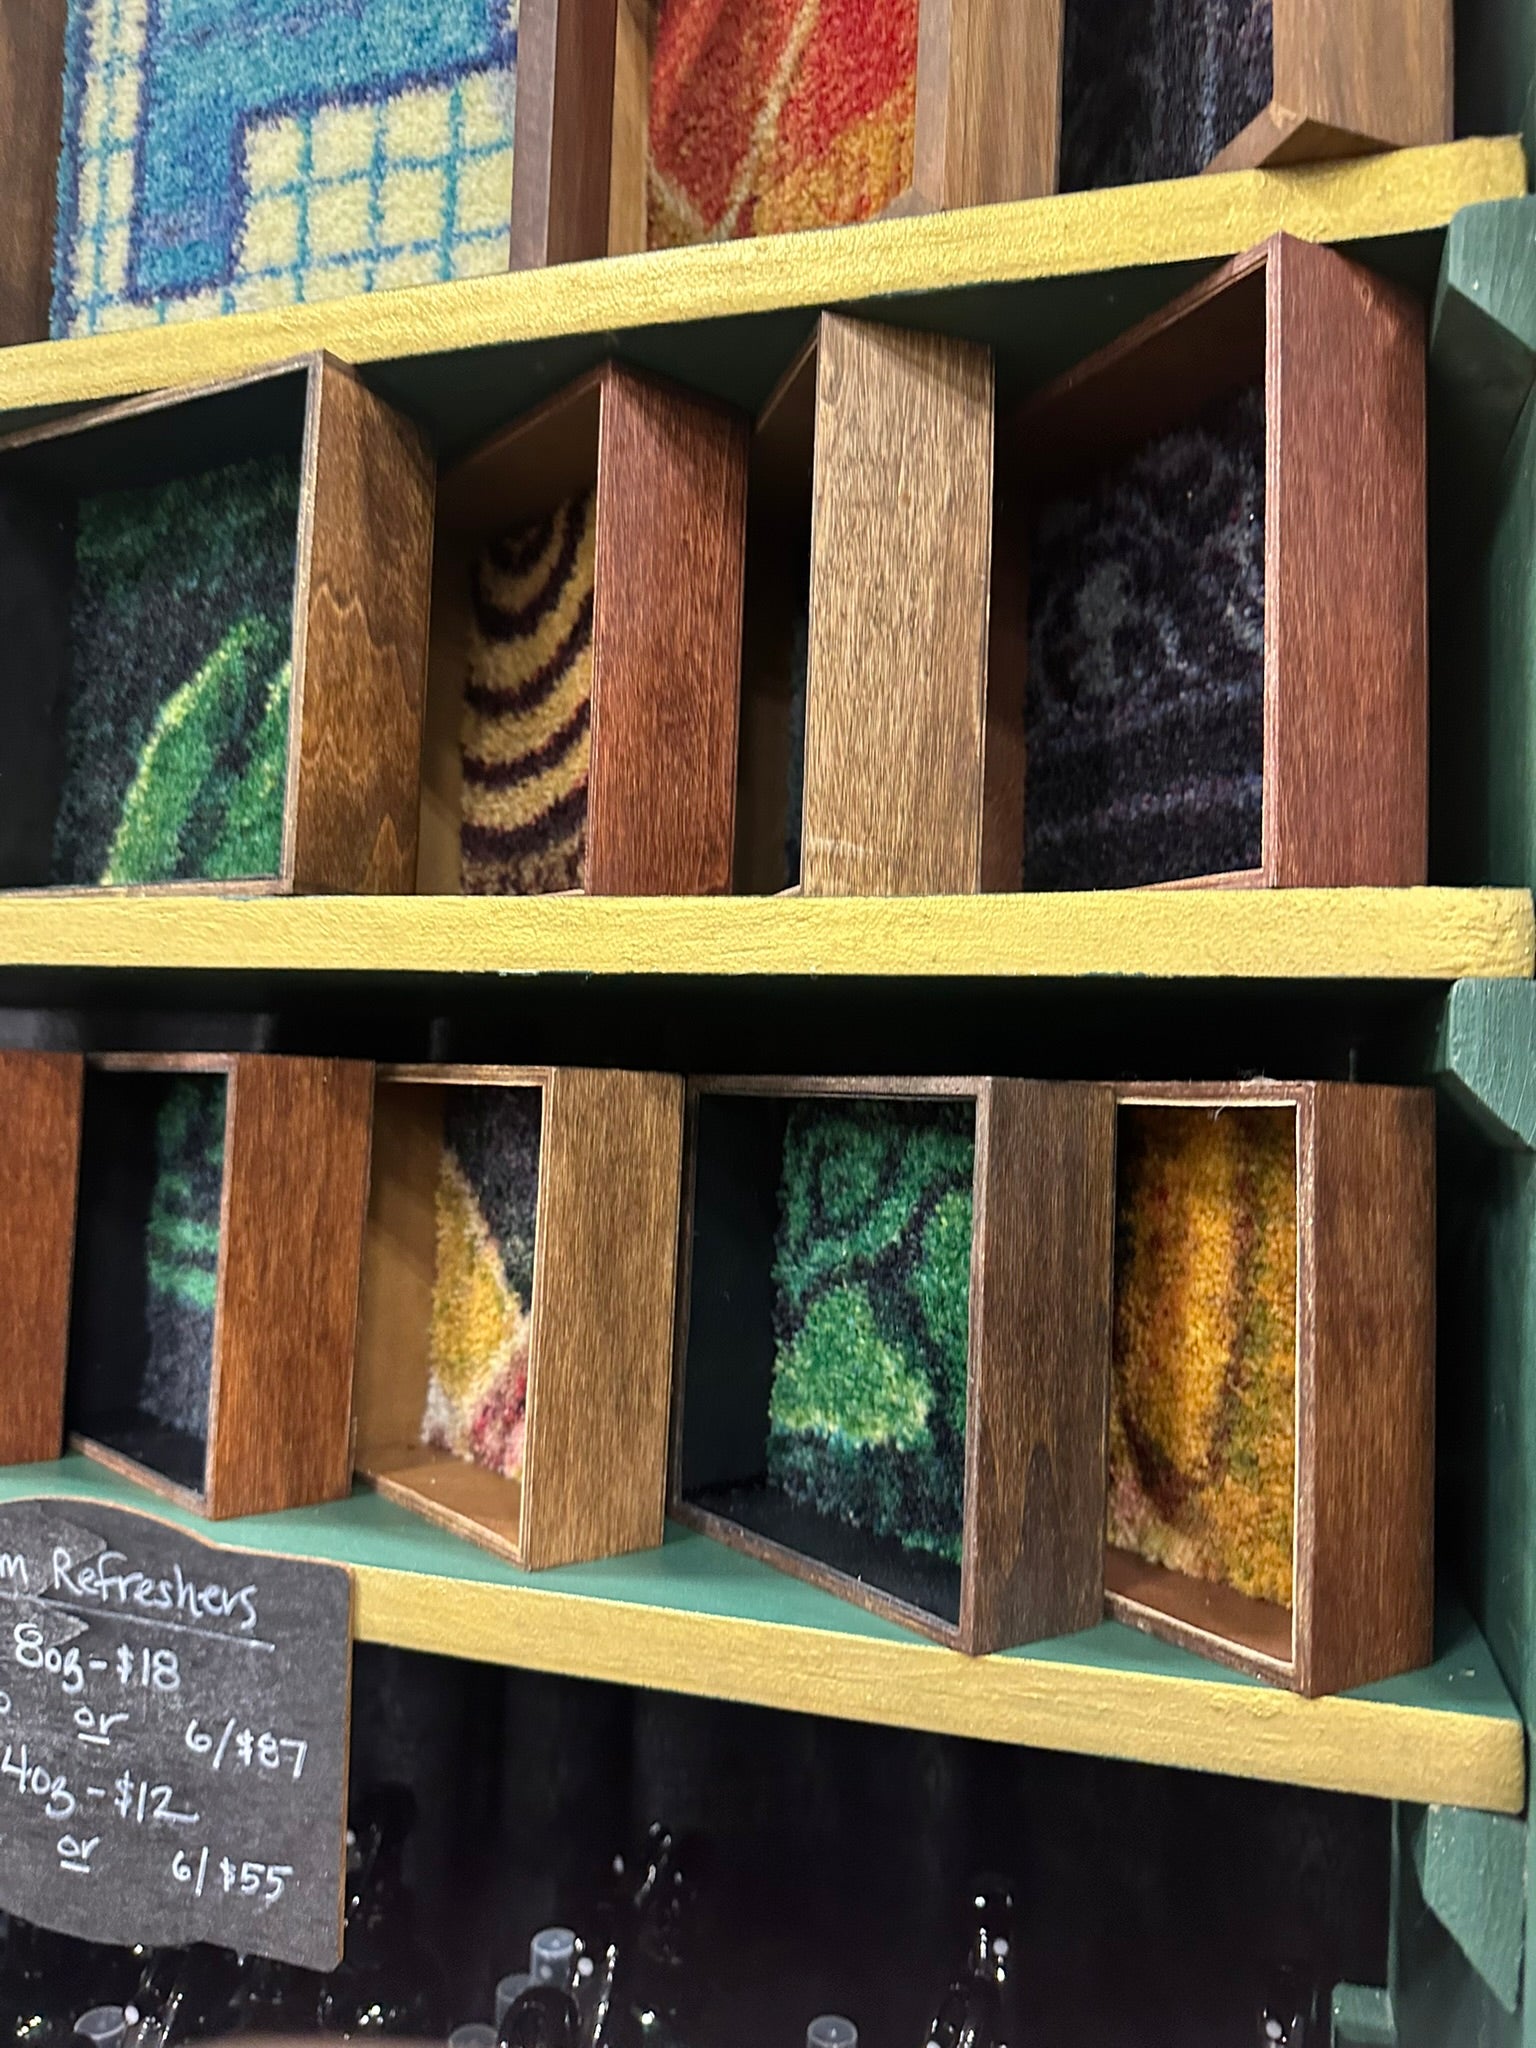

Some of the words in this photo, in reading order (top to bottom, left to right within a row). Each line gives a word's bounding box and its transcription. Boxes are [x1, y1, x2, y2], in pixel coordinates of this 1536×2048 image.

[52, 1546, 257, 1630] Refreshers
[74, 1705, 130, 1736] or
[185, 1717, 307, 1780] 6/$87
[57, 1834, 100, 1860] or
